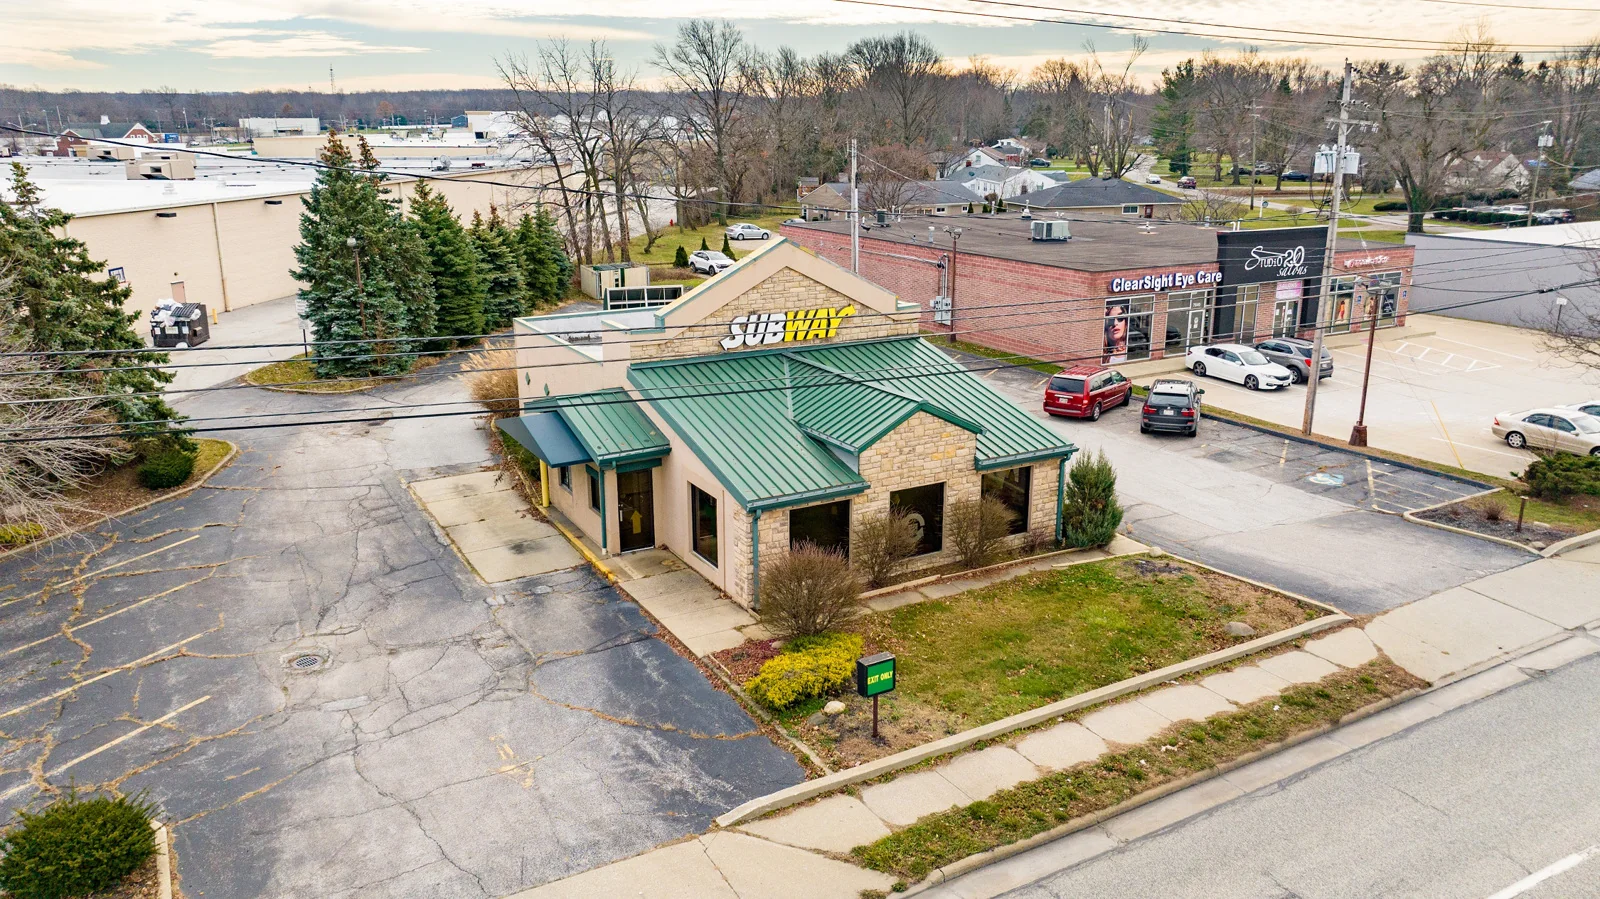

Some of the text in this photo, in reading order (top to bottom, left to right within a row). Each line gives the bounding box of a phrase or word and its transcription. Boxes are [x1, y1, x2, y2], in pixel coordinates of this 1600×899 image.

[1284, 246, 1305, 267] 20
[1111, 270, 1223, 292] ClearSight Eye Care
[1277, 265, 1308, 277] salons
[719, 304, 857, 351] SUBWAY
[867, 670, 893, 685] EXIT ONLY
